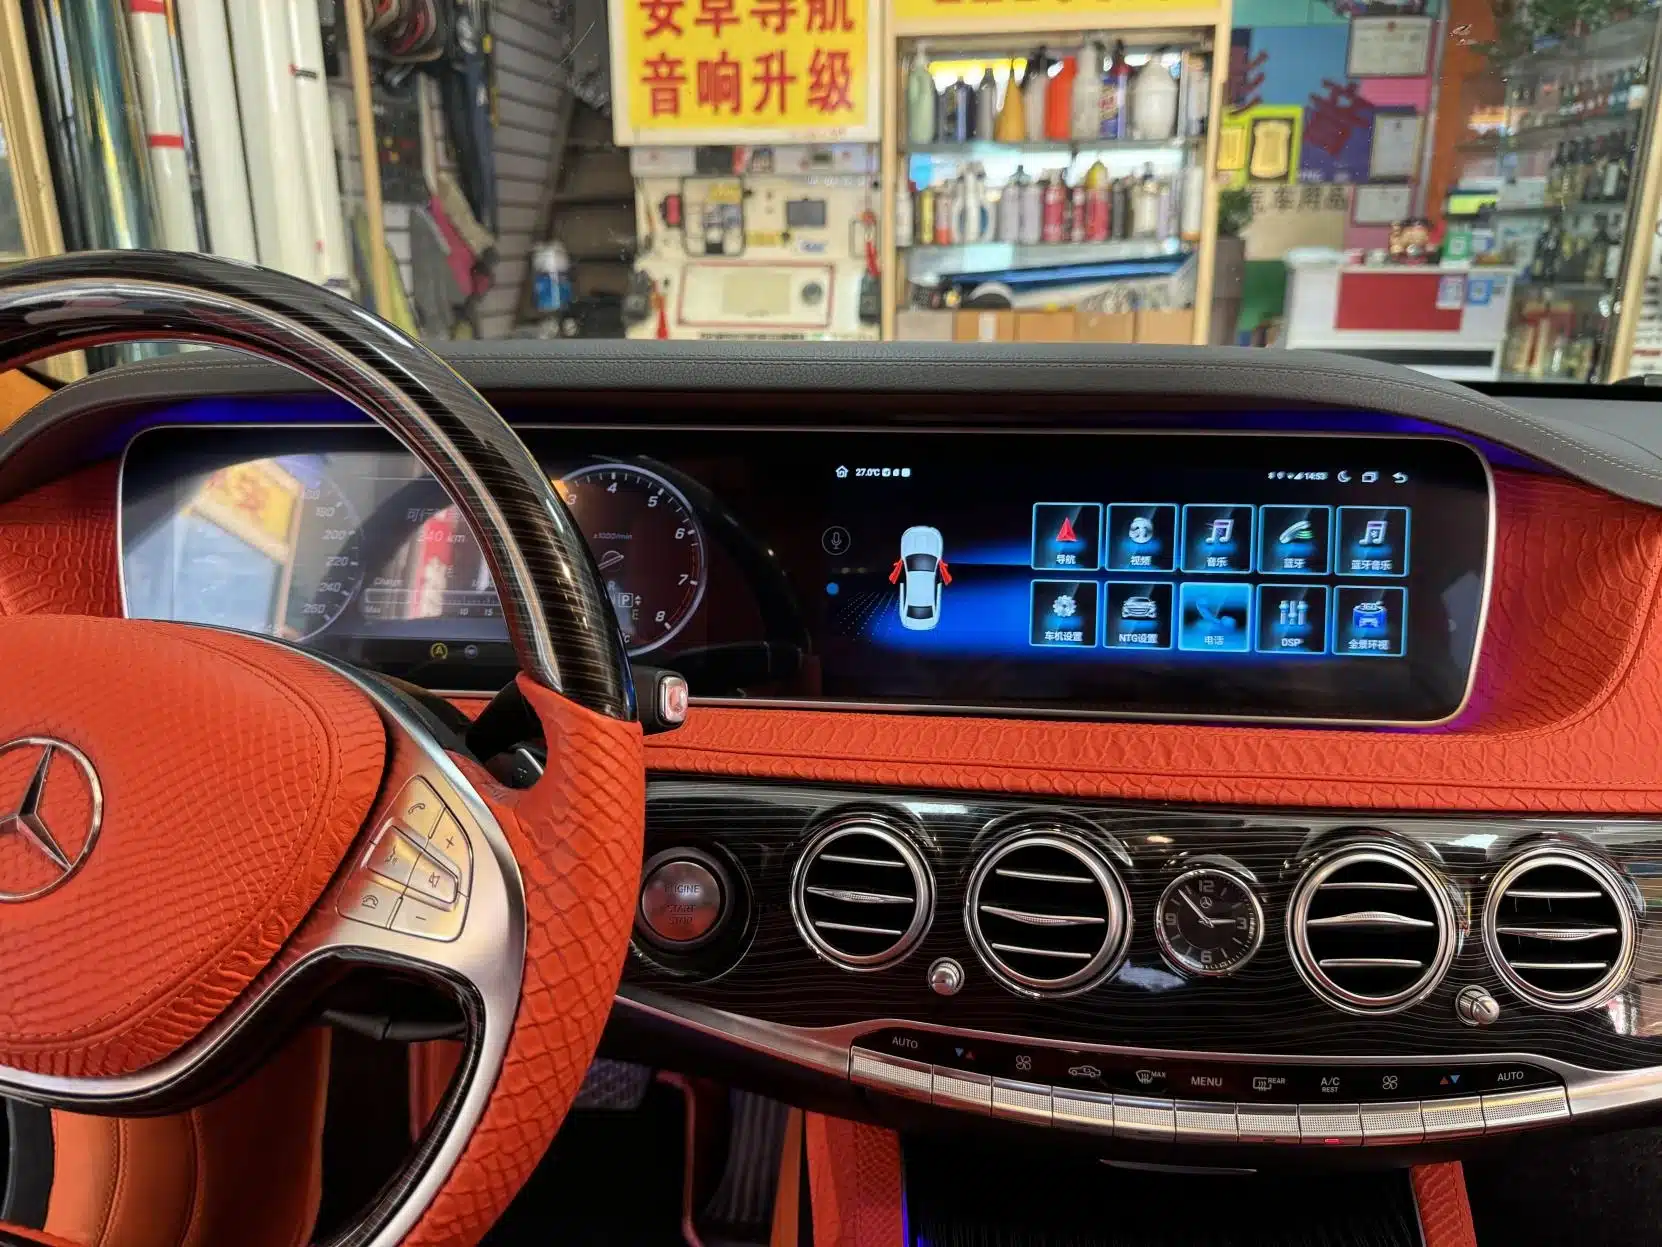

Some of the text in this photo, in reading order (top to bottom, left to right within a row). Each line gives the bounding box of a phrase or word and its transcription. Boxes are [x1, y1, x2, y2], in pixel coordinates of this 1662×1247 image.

[640, 49, 854, 117] 音响升级
[1303, 471, 1328, 481] 14:53
[606, 482, 618, 494] 4
[567, 494, 577, 505] 3
[647, 495, 659, 508] 5
[322, 529, 346, 540] 200
[674, 527, 686, 540] 6
[325, 556, 350, 567] 220
[1055, 554, 1077, 565] 导航
[1130, 555, 1152, 566] 视频
[1206, 556, 1229, 567] 音乐
[1283, 557, 1306, 569] 蓝牙
[1351, 559, 1393, 571] 蓝牙音乐
[677, 574, 689, 586] 7
[319, 582, 342, 593] 240
[622, 594, 631, 606] P
[302, 603, 326, 614] 260
[655, 610, 666, 623] 8
[1044, 631, 1084, 642] 车机设置
[1118, 633, 1159, 644] NTG设置
[1204, 635, 1225, 646] 电话
[1281, 637, 1302, 647] DSP
[1348, 639, 1391, 651] 全景环视
[1198, 879, 1215, 893] 12
[666, 903, 696, 913] START
[668, 916, 693, 926] STOP
[1165, 912, 1177, 926] 9
[1236, 916, 1248, 930] 3
[1200, 950, 1213, 964] 6
[891, 1035, 919, 1050] AUTO
[1151, 1070, 1167, 1079] MAX
[1496, 1071, 1525, 1082] AUTO
[1190, 1076, 1223, 1087] MENU
[1267, 1077, 1286, 1086] REAR
[1320, 1076, 1341, 1087] A/C
[1321, 1086, 1339, 1094] REST
